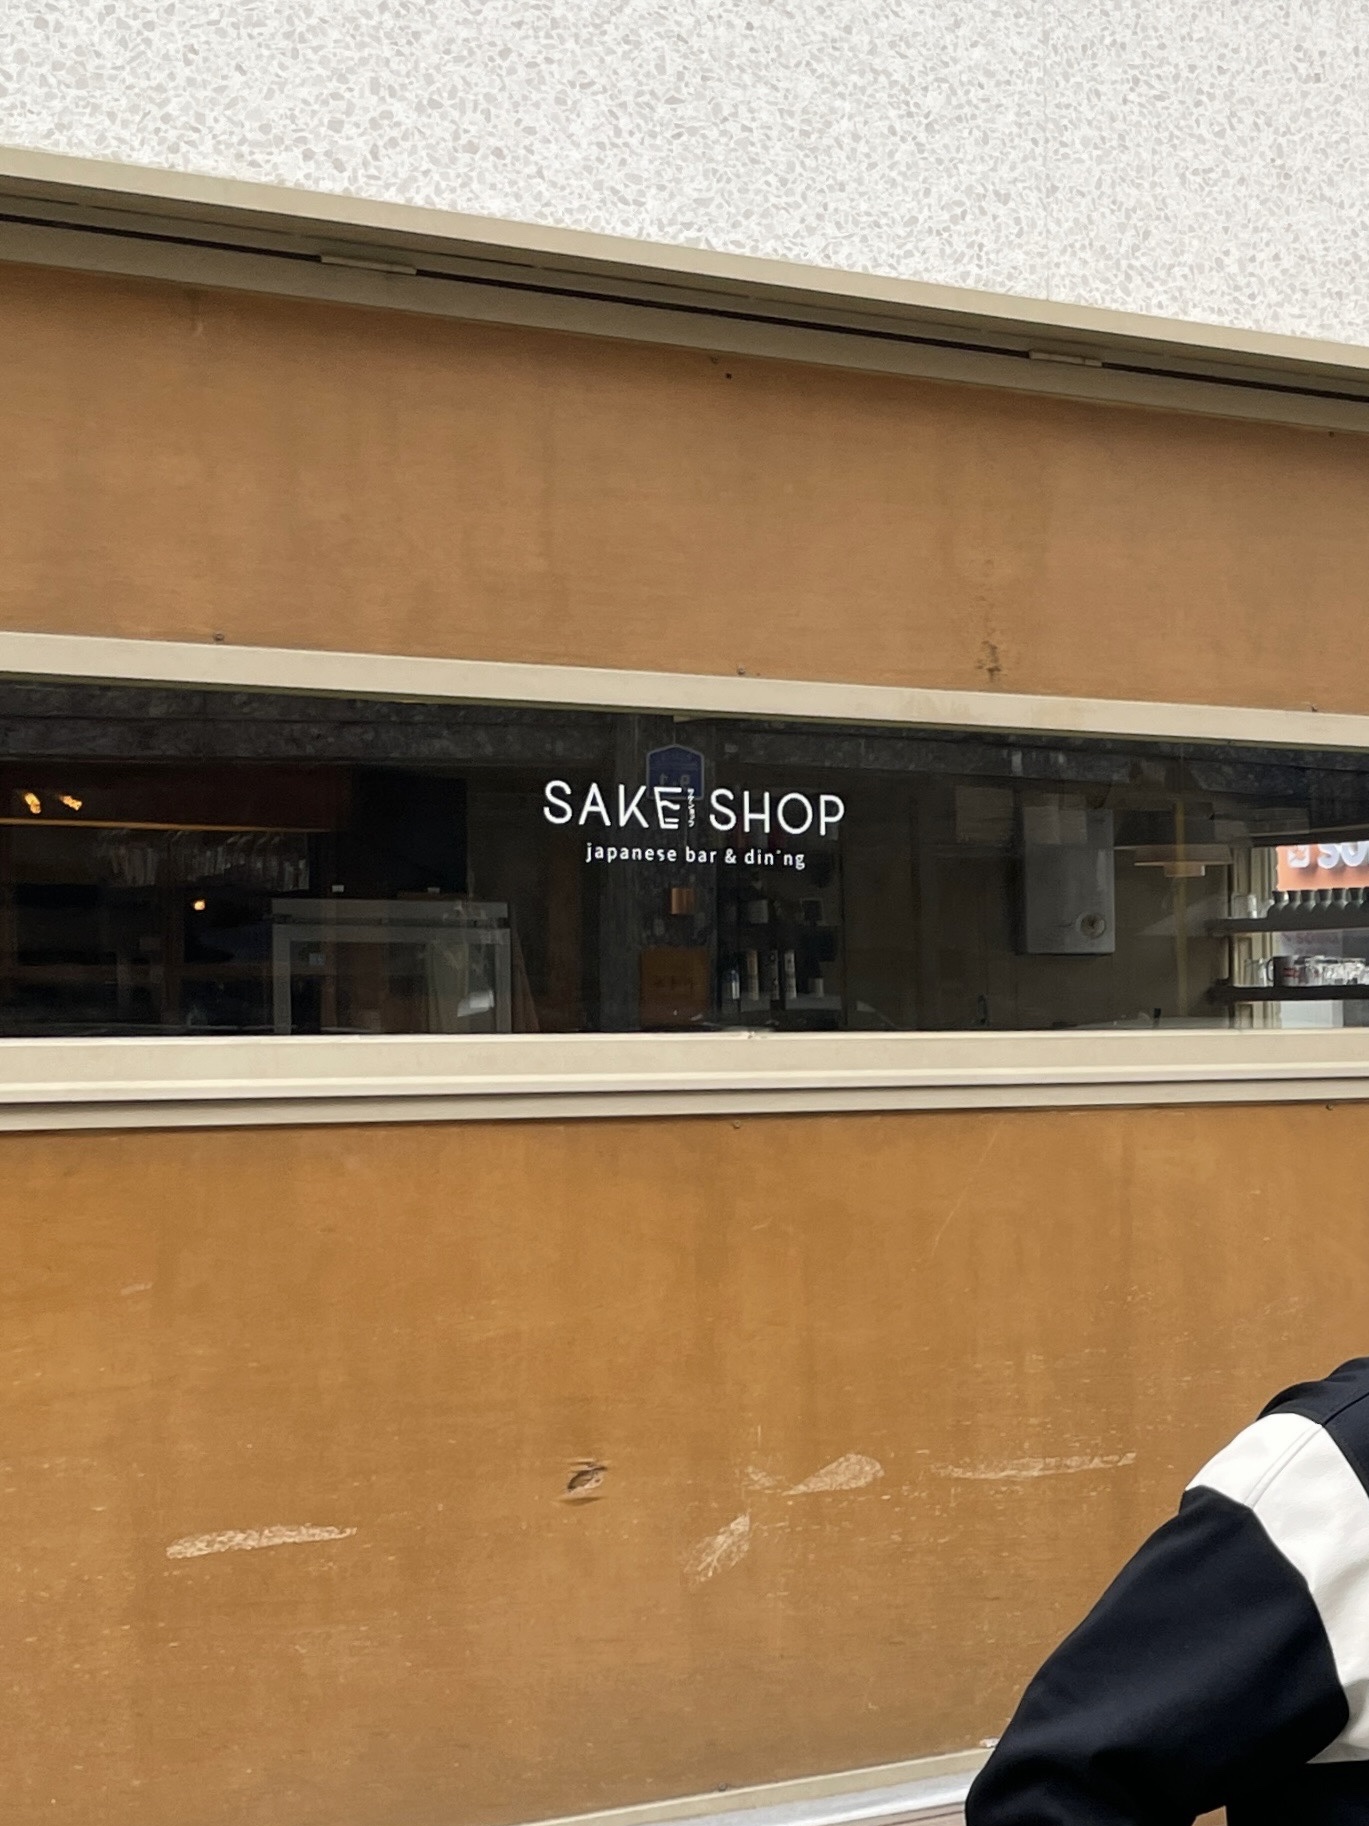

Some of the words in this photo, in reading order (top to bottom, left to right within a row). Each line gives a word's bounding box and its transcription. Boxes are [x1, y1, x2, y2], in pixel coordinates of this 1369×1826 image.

[543, 780, 683, 830] SAKE
[709, 788, 846, 837] SHOP
[585, 842, 677, 863] japanese
[685, 845, 717, 864] bar
[724, 847, 738, 864] &
